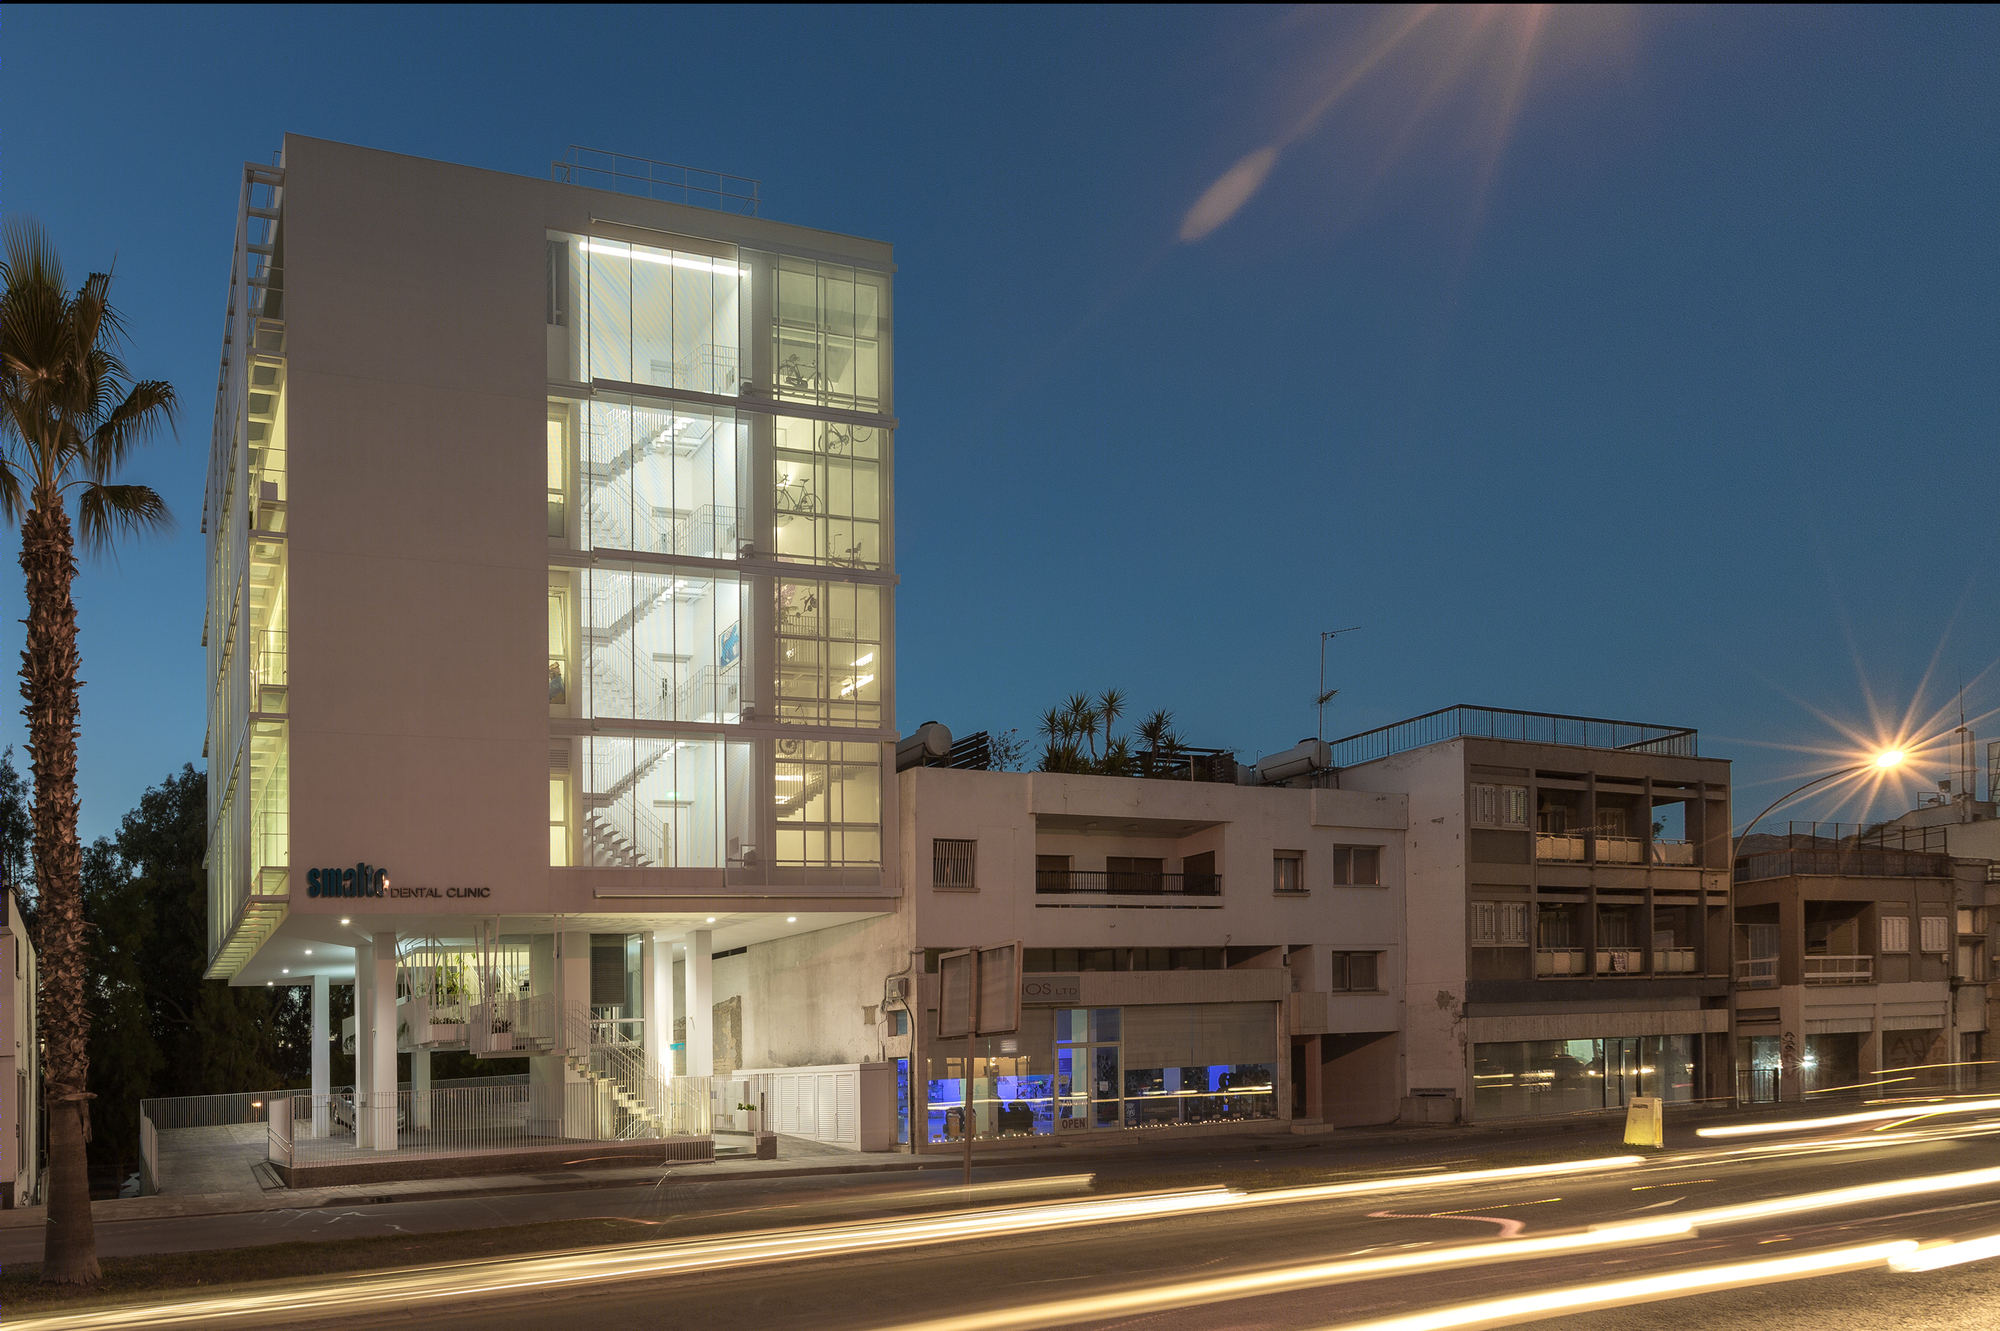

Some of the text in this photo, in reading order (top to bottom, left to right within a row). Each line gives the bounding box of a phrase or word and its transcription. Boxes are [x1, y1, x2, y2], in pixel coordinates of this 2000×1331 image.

[306, 862, 491, 898] smalto DENTAL CLINIC
[1055, 987, 1078, 995] LTD
[1061, 1118, 1086, 1129] OPEN
